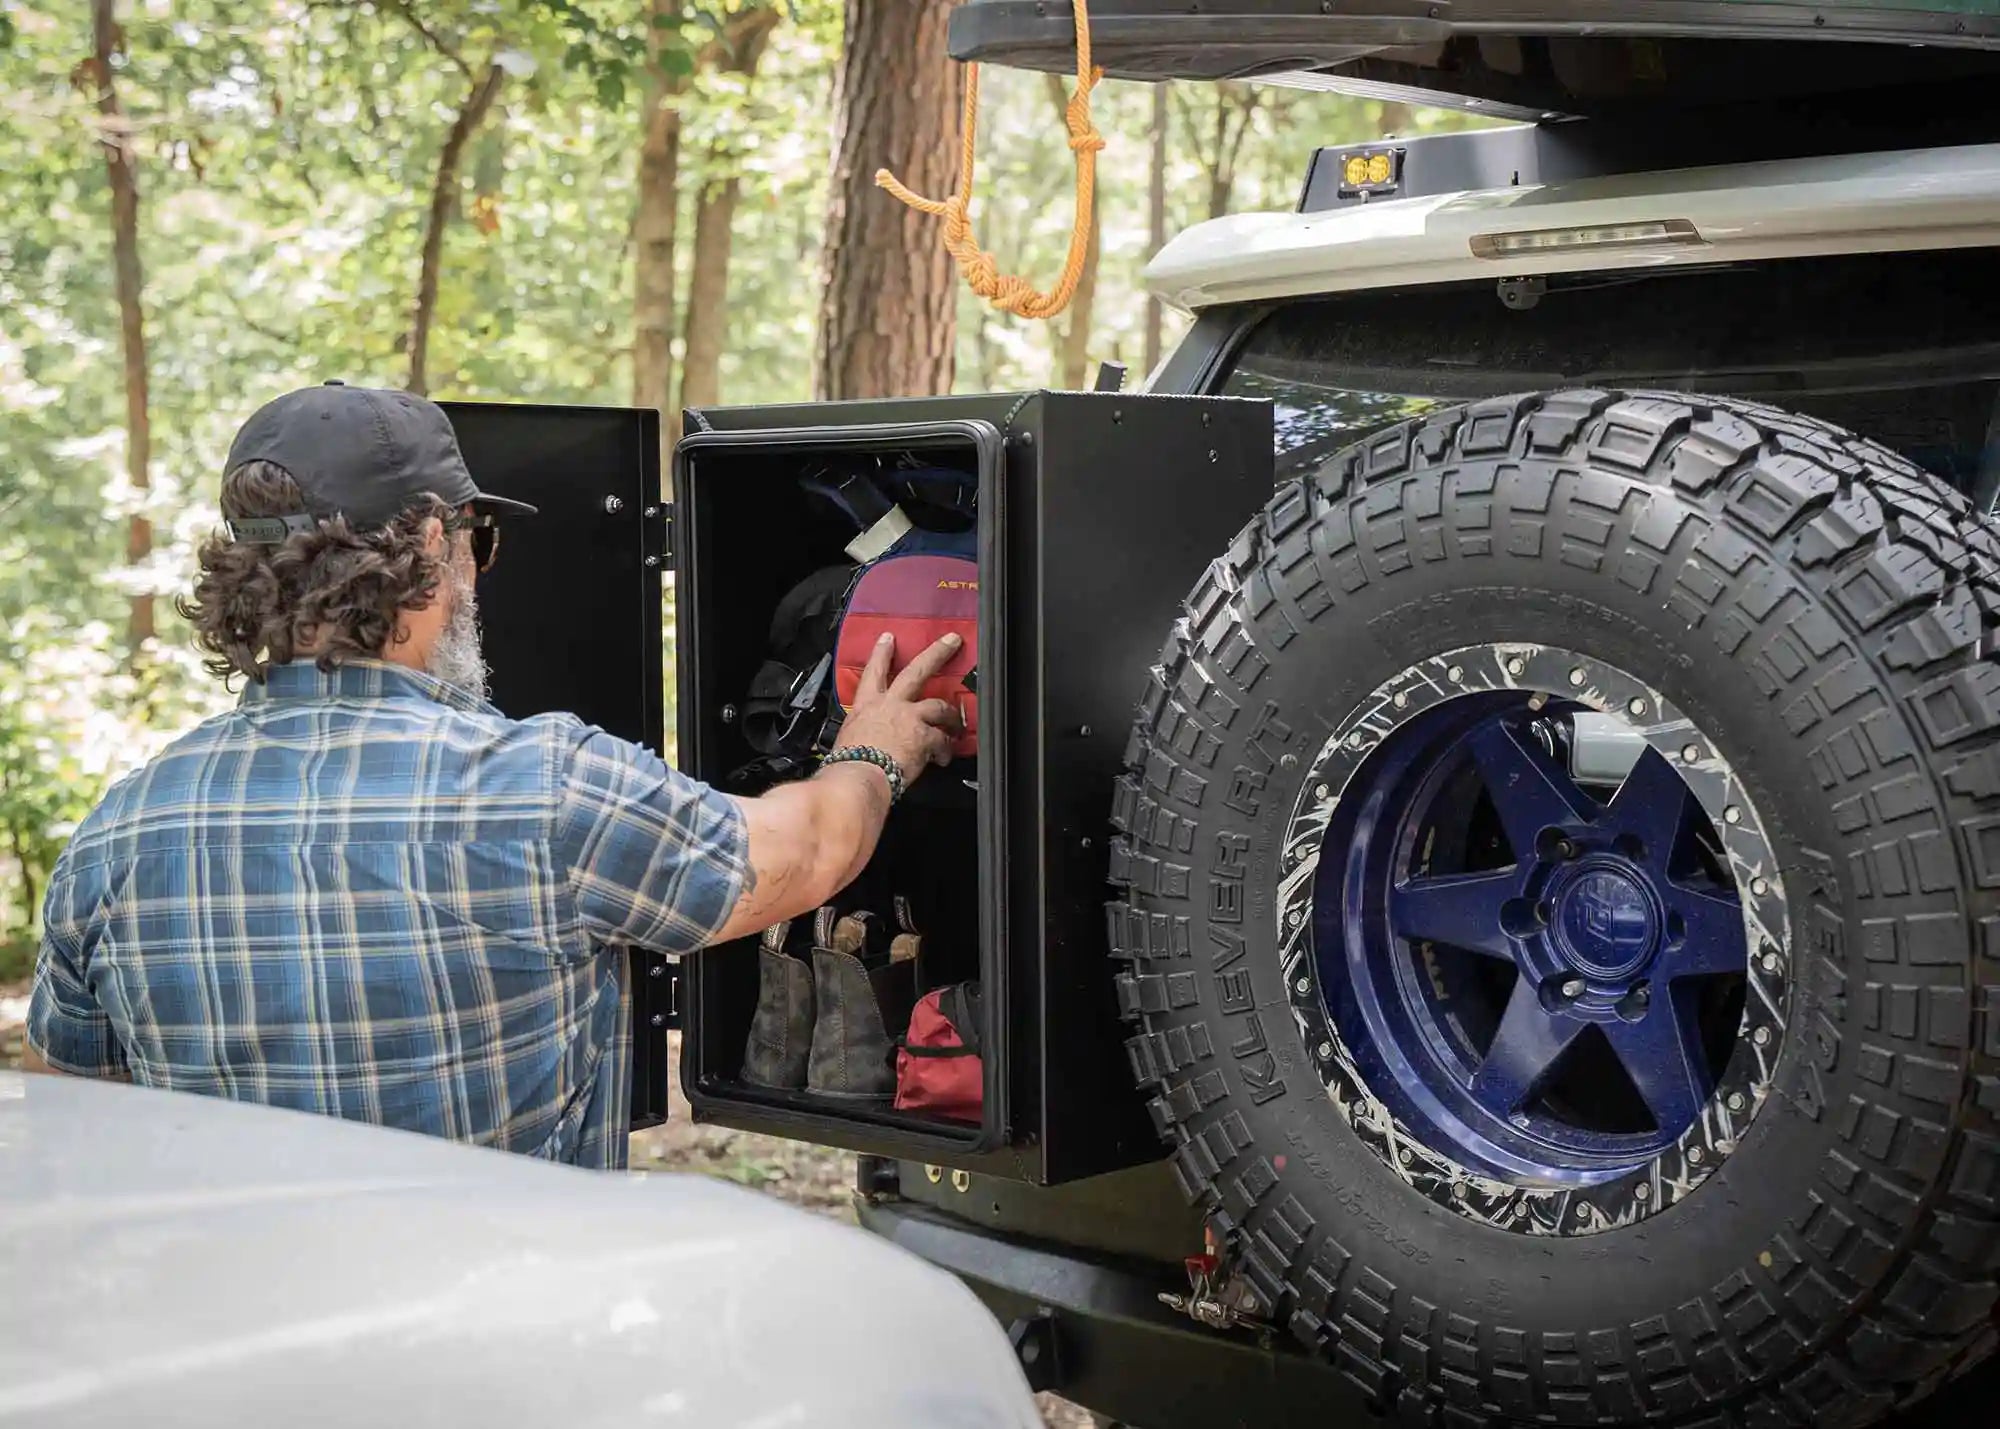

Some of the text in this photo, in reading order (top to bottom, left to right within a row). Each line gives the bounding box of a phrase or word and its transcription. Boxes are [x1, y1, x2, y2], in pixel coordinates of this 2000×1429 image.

[936, 580, 978, 591] ASTR
[1223, 699, 1292, 817] R/T
[1208, 830, 1287, 1106] KLEVER
